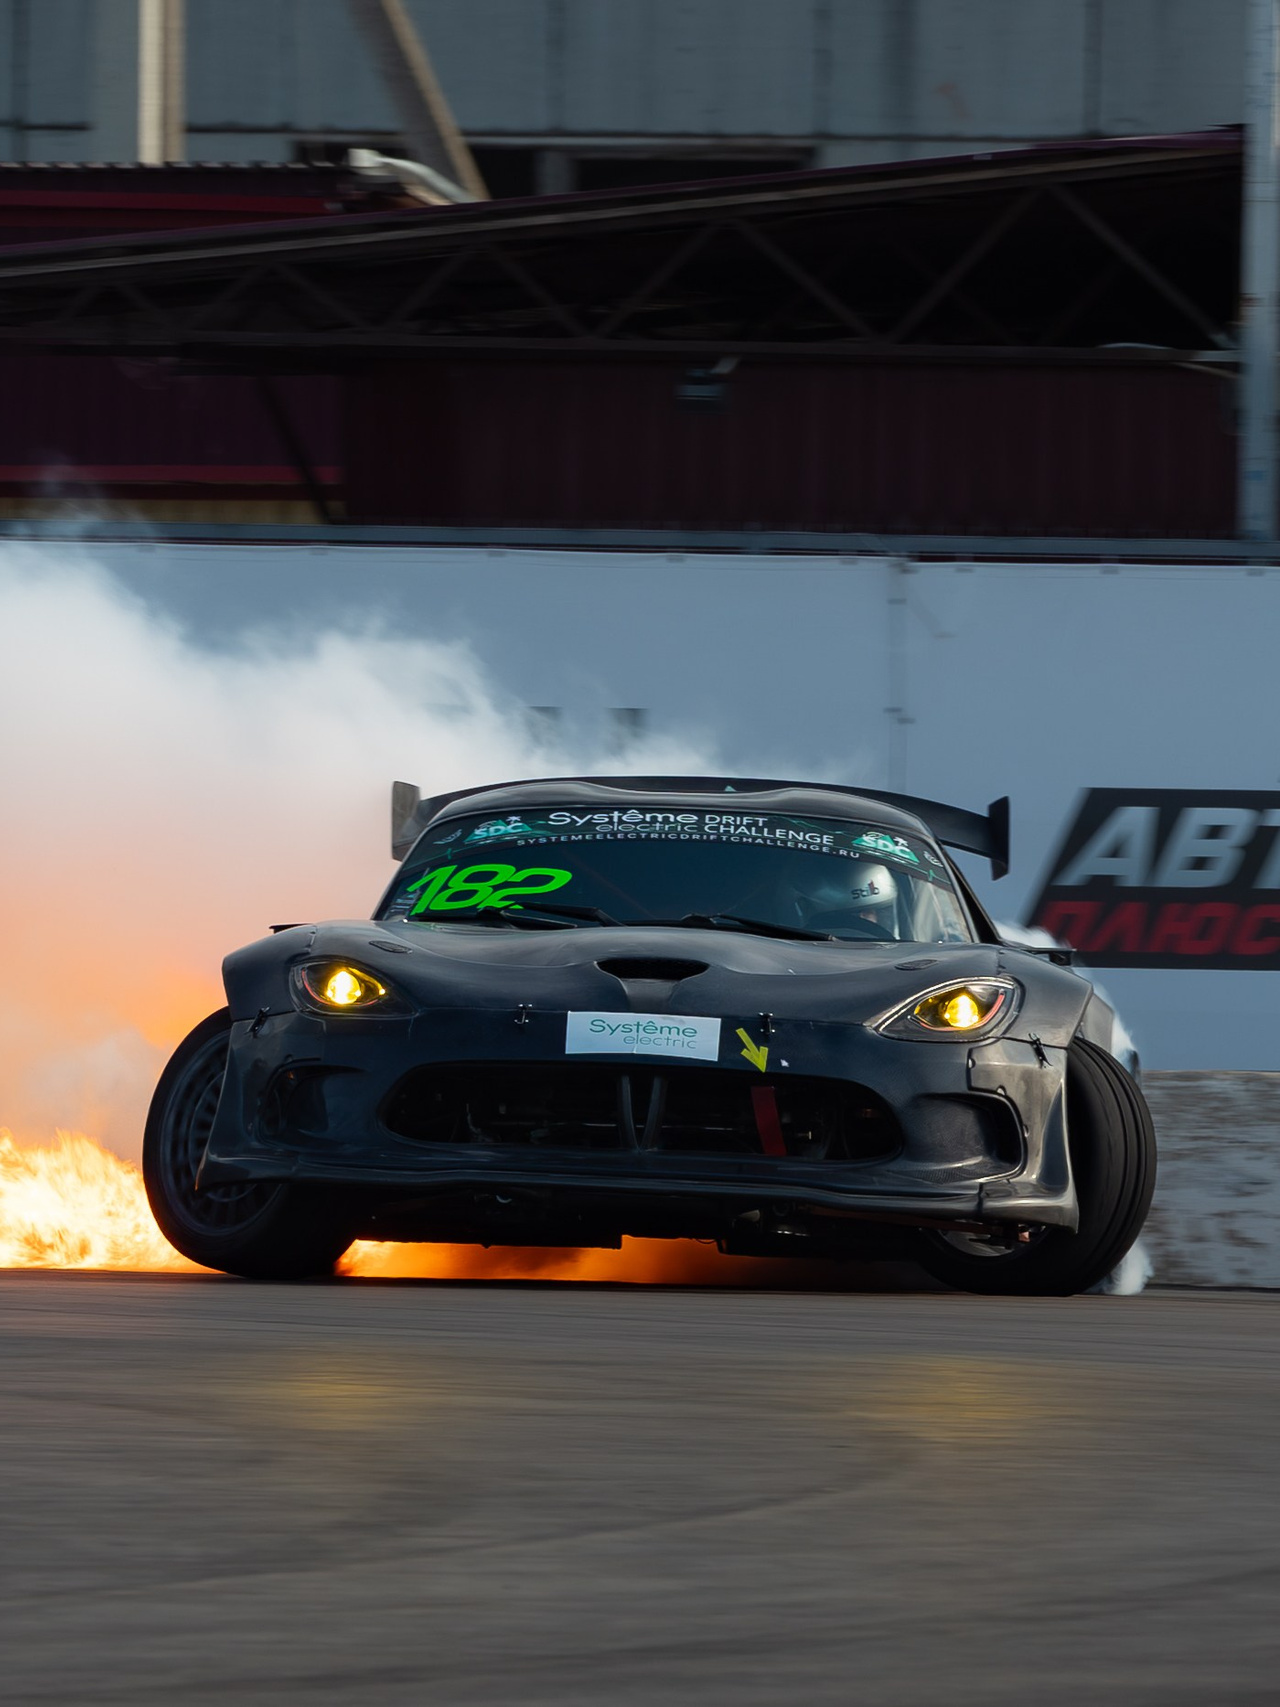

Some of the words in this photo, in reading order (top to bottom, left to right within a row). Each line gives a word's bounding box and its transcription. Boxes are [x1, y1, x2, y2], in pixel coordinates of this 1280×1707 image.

[547, 809, 699, 826] Systême
[704, 815, 768, 827] DRIFT
[472, 822, 524, 840] SDC
[595, 821, 698, 833] electric
[704, 823, 834, 846] CHALLENGE
[861, 837, 912, 859] SDC
[406, 863, 573, 916] 182
[588, 1018, 698, 1038] Systême
[622, 1033, 698, 1050] electric
